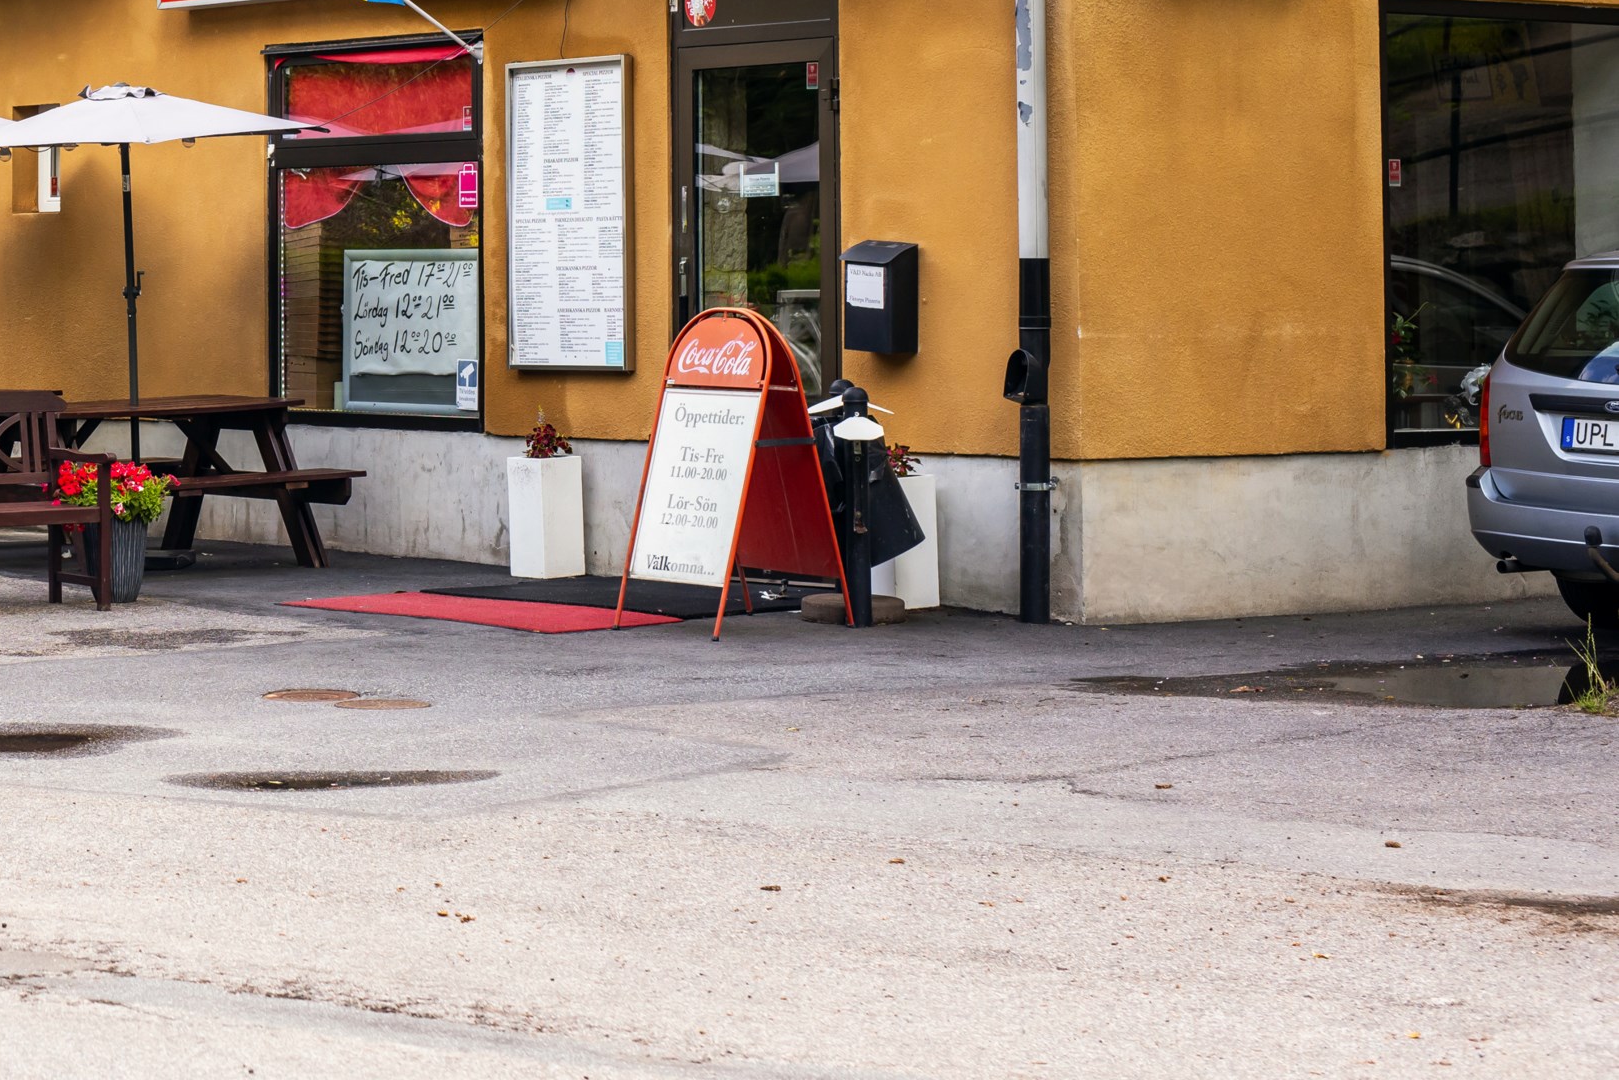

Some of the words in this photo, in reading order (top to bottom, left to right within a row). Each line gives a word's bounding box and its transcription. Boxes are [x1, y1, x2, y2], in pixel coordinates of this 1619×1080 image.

[353, 293, 389, 328] Lördag
[354, 330, 390, 362] Söndag
[674, 403, 745, 428] Öppettider:
[680, 446, 725, 464] Tis-Fre
[669, 465, 728, 481] 11.00-20.00
[667, 493, 718, 512] Lör-Sön
[660, 512, 719, 529] 12.00-20.00
